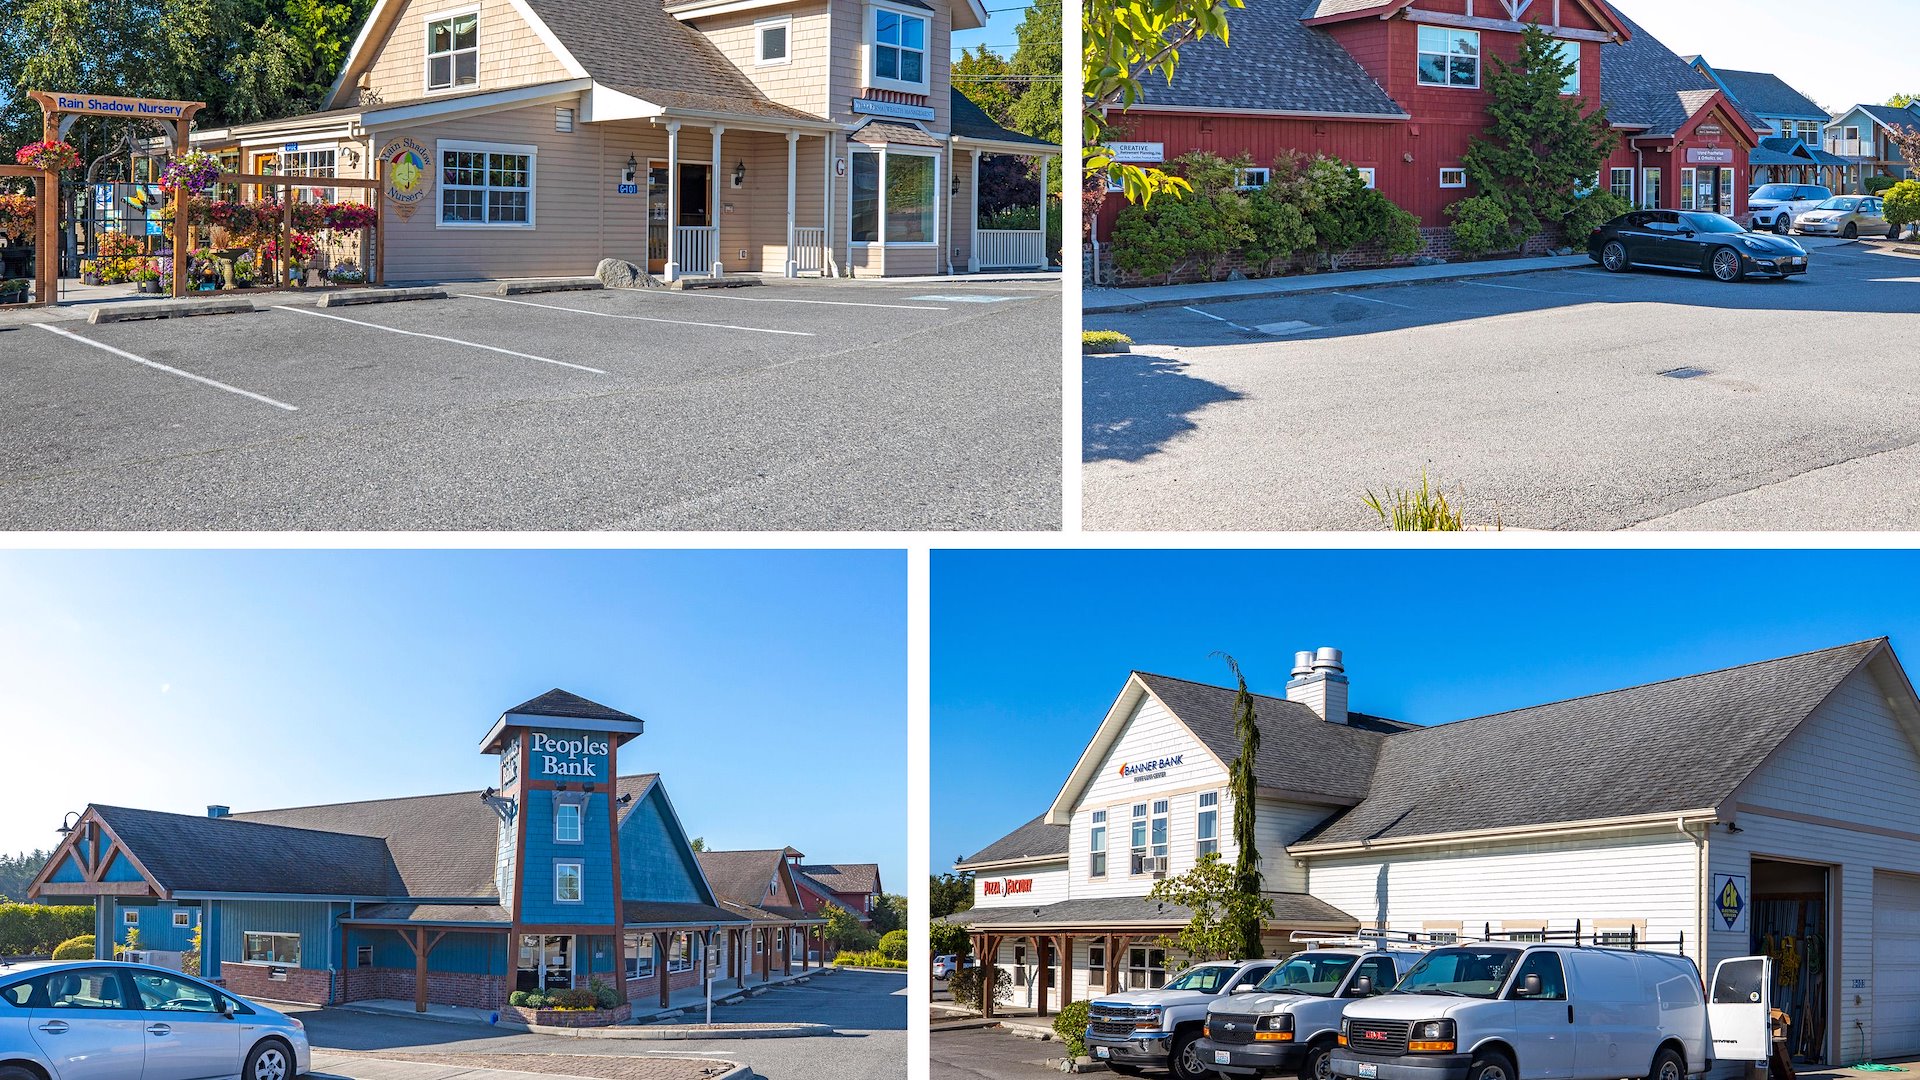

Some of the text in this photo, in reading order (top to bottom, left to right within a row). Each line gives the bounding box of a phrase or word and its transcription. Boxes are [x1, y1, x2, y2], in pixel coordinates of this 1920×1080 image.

[59, 97, 182, 116] Rain Shadow Nursery
[382, 138, 432, 165] Rain Shadow
[836, 158, 845, 176] G
[388, 187, 424, 202] Nursery
[532, 732, 608, 760] Peoples
[542, 755, 596, 777] Bank
[1125, 754, 1183, 776] BANNER BANK
[1153, 771, 1166, 780] CENTER
[984, 879, 1032, 896] PIZZA FACTORY
[1722, 882, 1738, 908] CK
[1365, 1030, 1388, 1041] GMC
